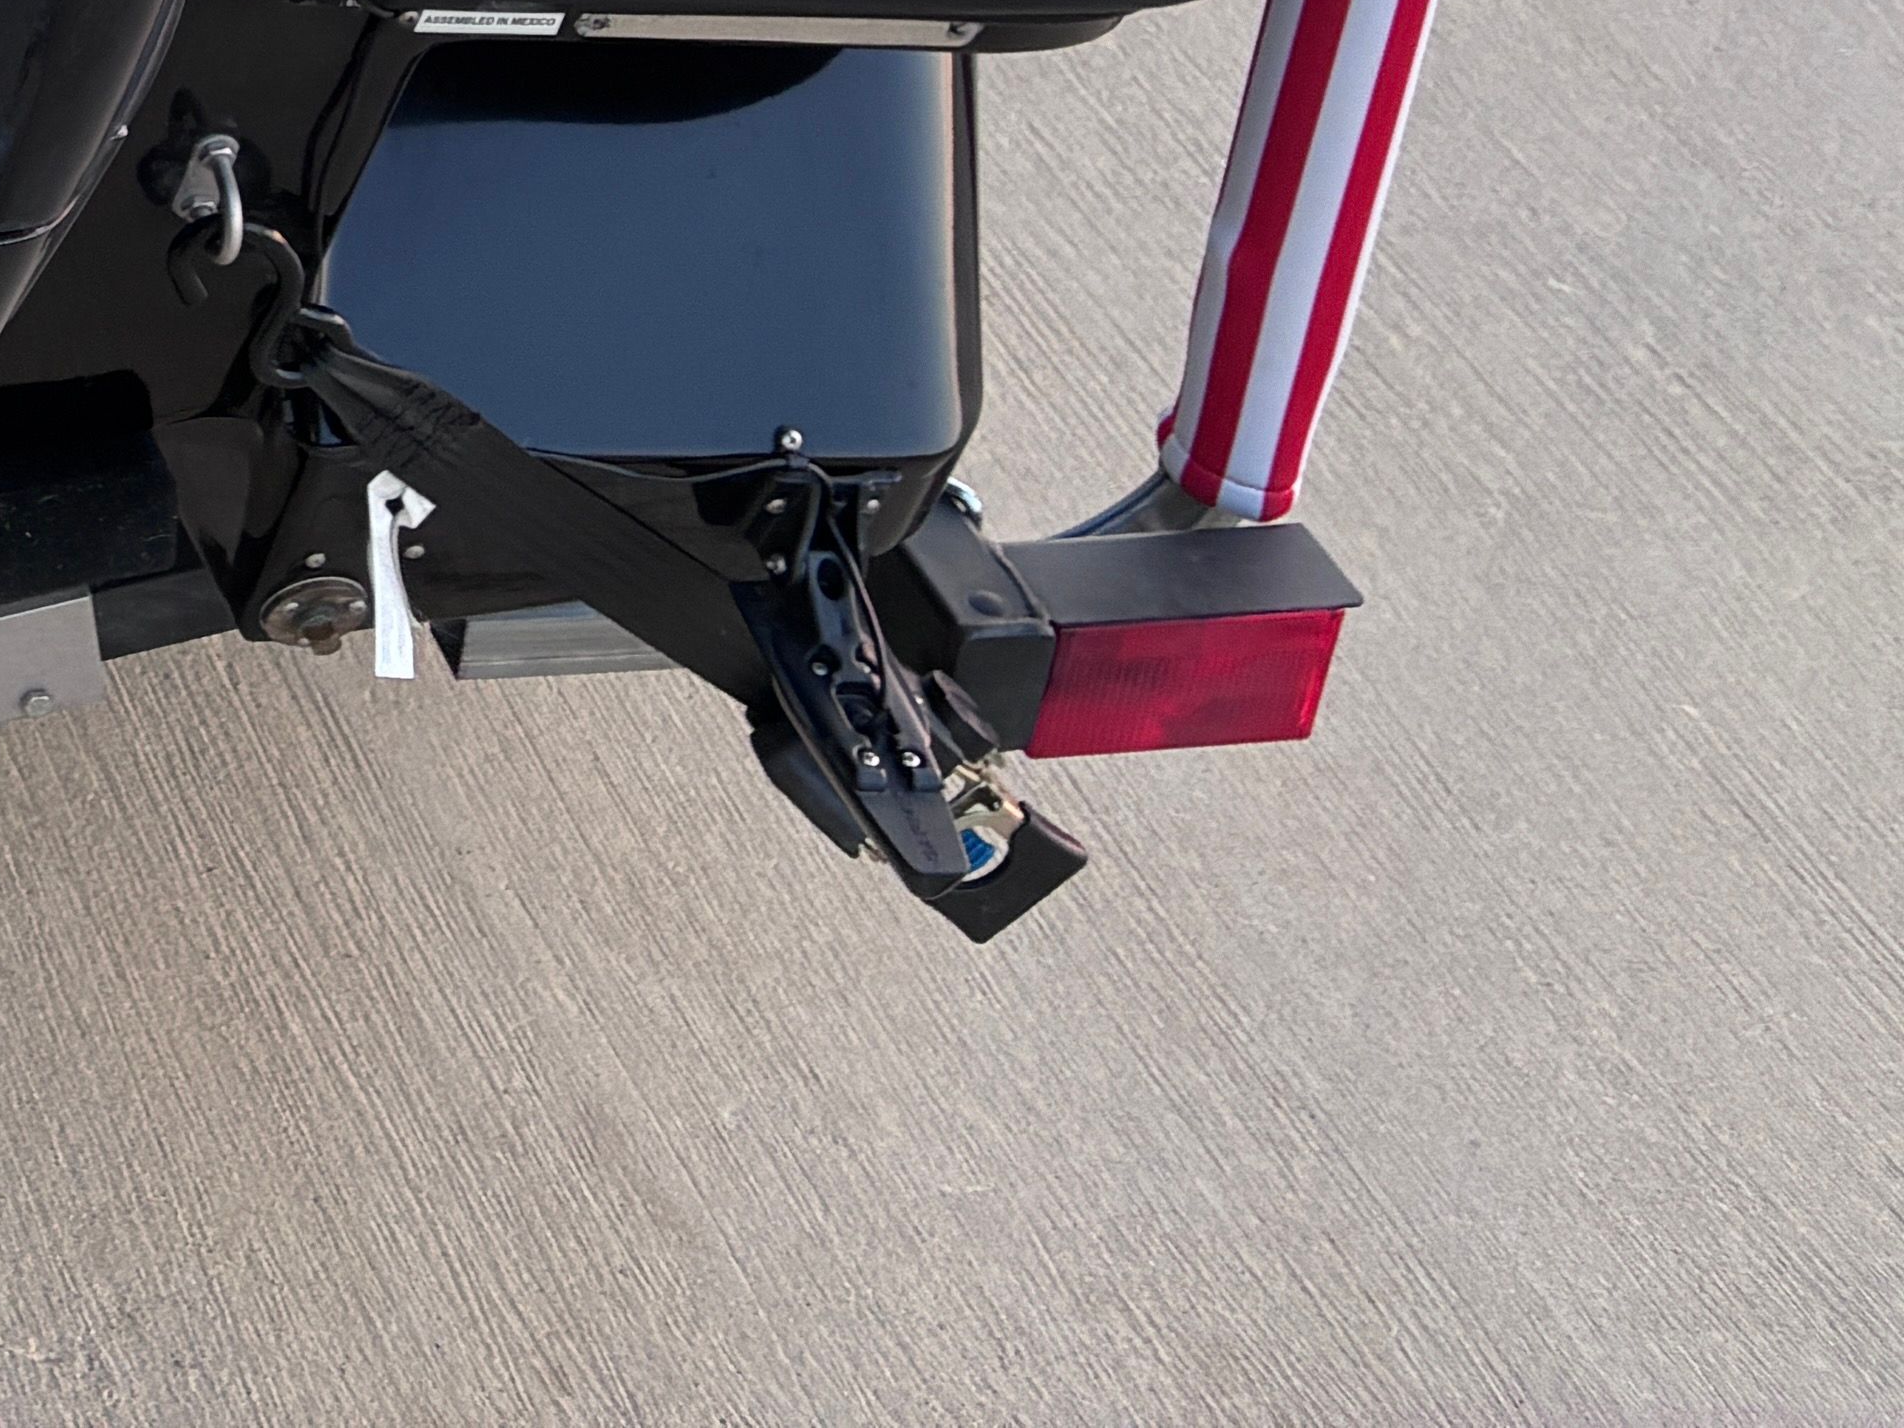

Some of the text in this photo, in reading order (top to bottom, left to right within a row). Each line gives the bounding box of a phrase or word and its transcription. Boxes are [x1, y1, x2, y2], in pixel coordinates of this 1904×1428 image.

[423, 15, 556, 27] ASSEMBLED IN MEXICO
